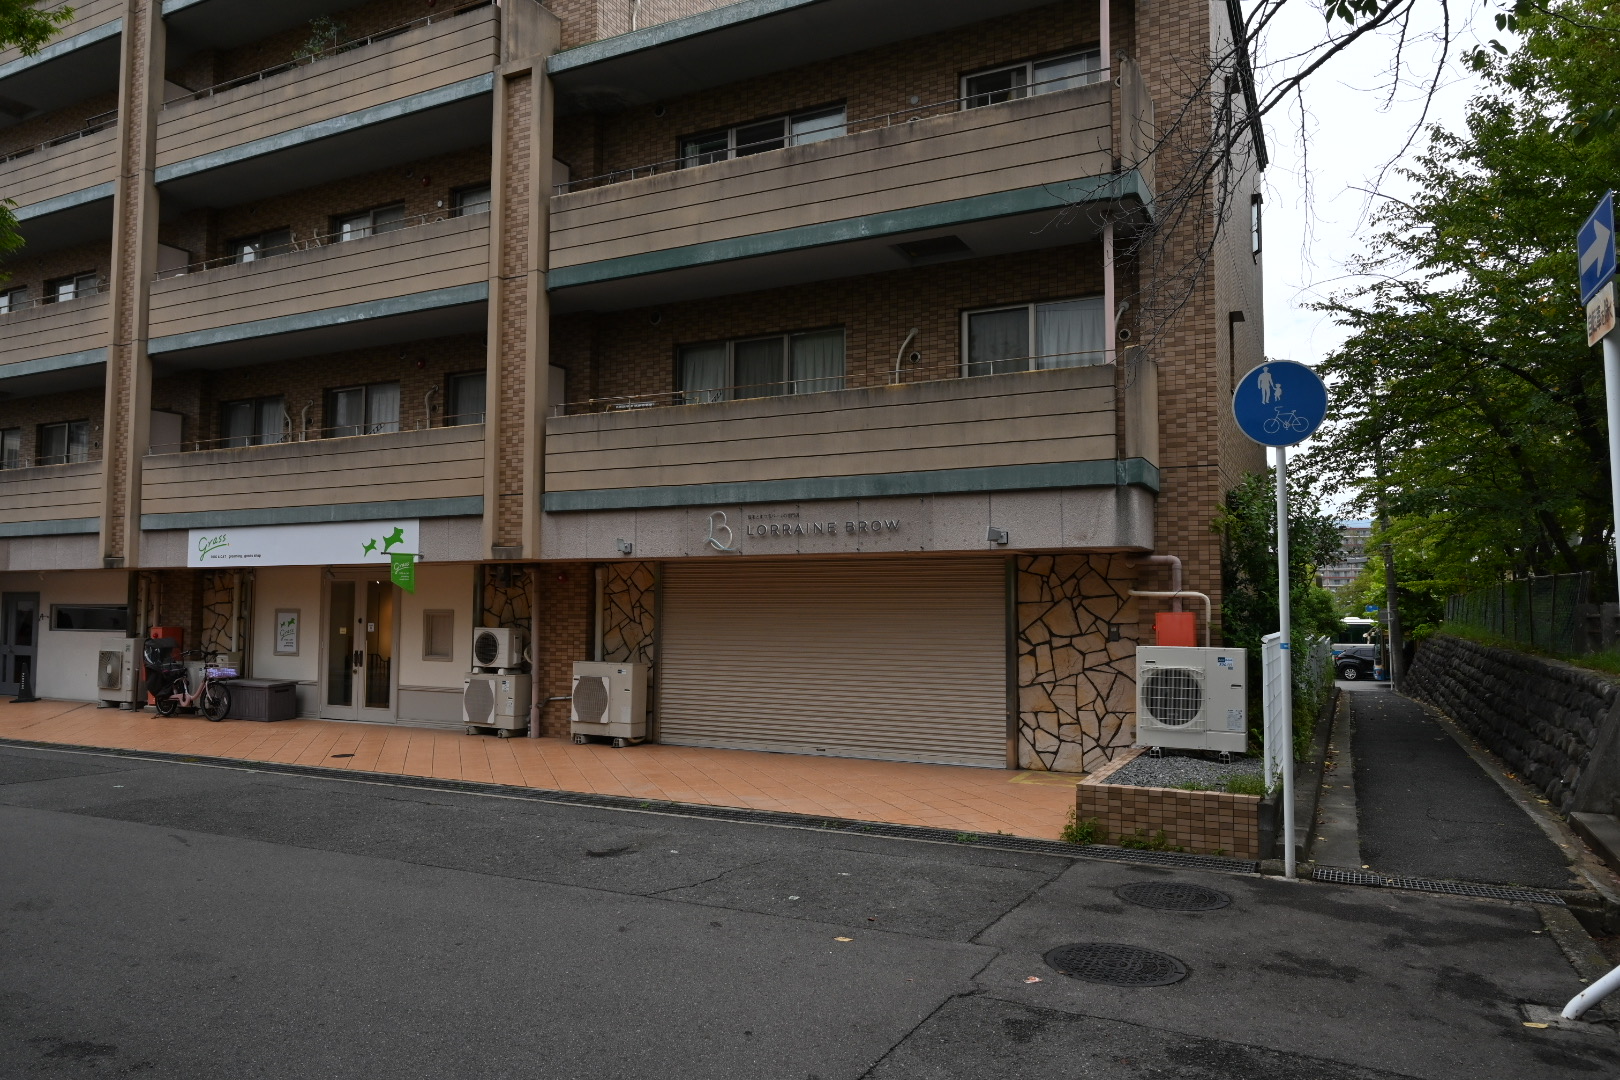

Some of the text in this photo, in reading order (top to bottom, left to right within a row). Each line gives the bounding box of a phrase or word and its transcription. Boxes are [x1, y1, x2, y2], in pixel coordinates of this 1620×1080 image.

[747, 519, 900, 536] LORRAINE BROW
[198, 533, 228, 562] Grass
